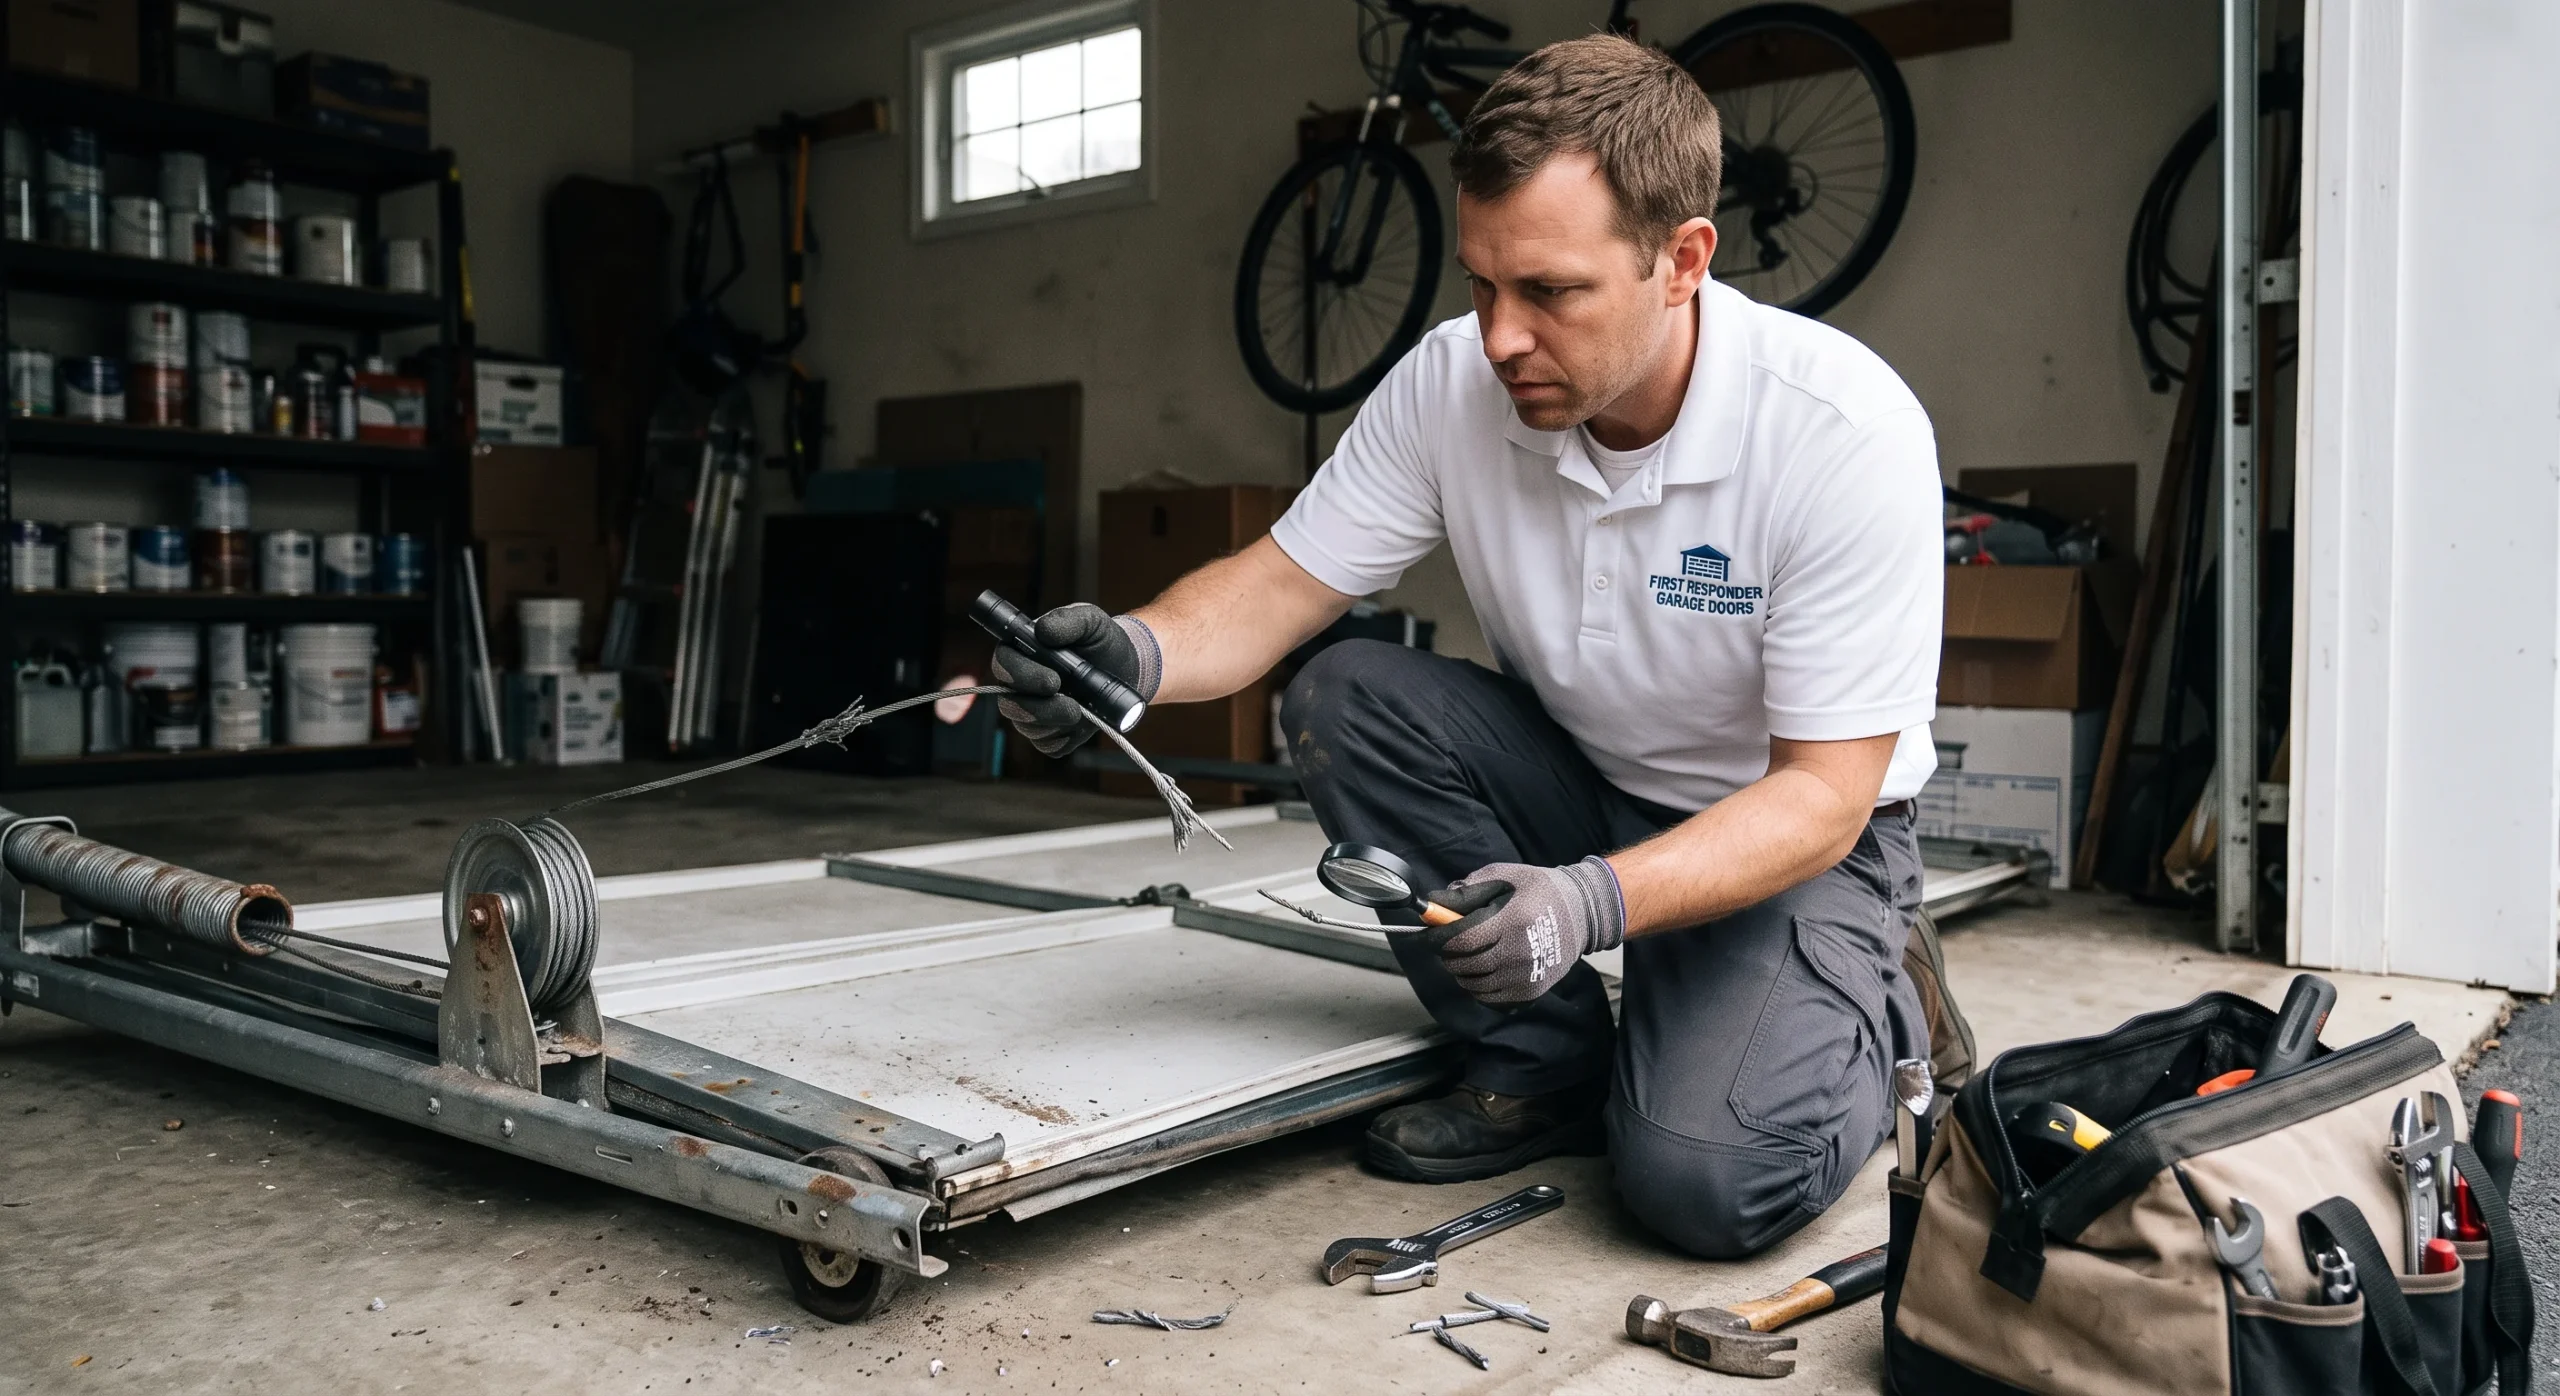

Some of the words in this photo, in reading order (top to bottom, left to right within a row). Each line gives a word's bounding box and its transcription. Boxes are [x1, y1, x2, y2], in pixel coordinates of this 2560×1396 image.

[1649, 575, 1685, 591] FIRST
[1687, 580, 1763, 599] RESPONDER
[1656, 592, 1705, 612] GARAGE
[1708, 600, 1754, 615] DOORS
